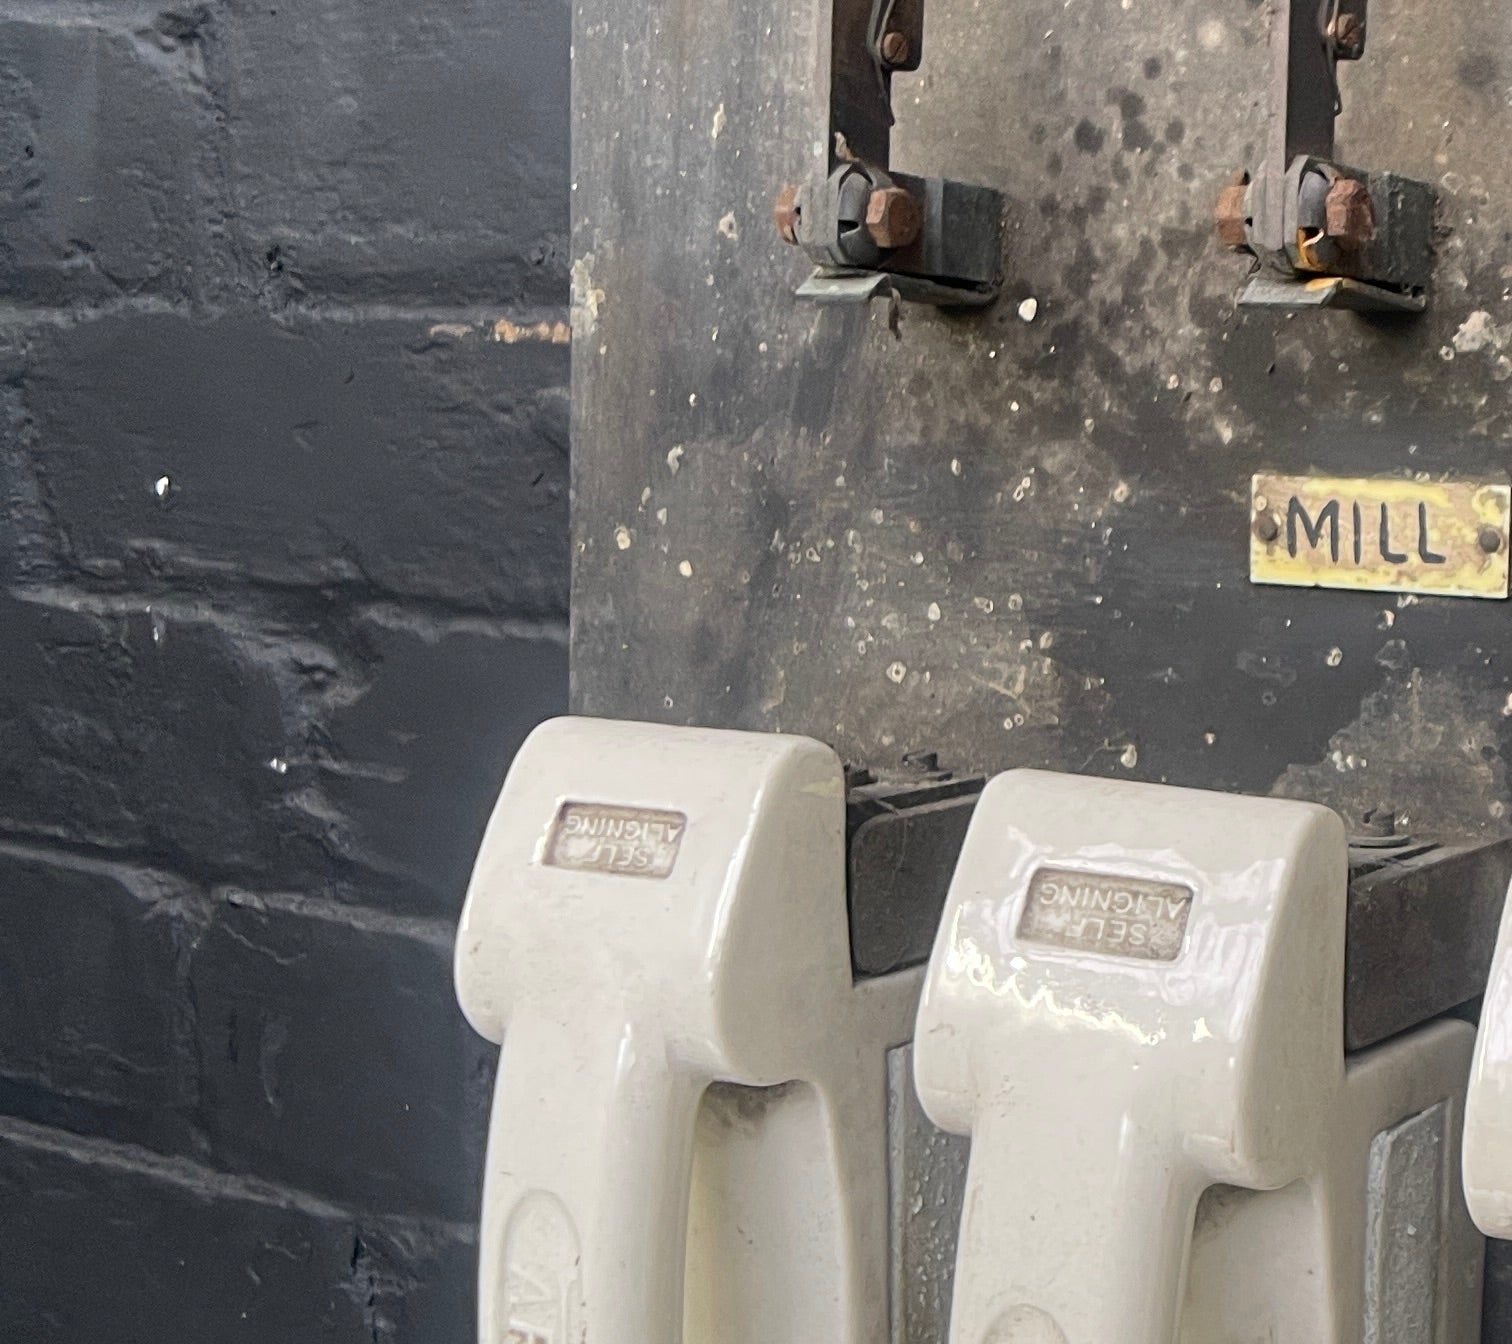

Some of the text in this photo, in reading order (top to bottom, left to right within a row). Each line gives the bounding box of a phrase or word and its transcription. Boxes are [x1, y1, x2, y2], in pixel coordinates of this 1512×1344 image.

[1286, 495, 1447, 565] MILL
[563, 815, 682, 843] ALIGNING
[583, 844, 650, 867] SELF
[1039, 882, 1187, 920] ALIGNING
[1064, 917, 1148, 945] SELF
